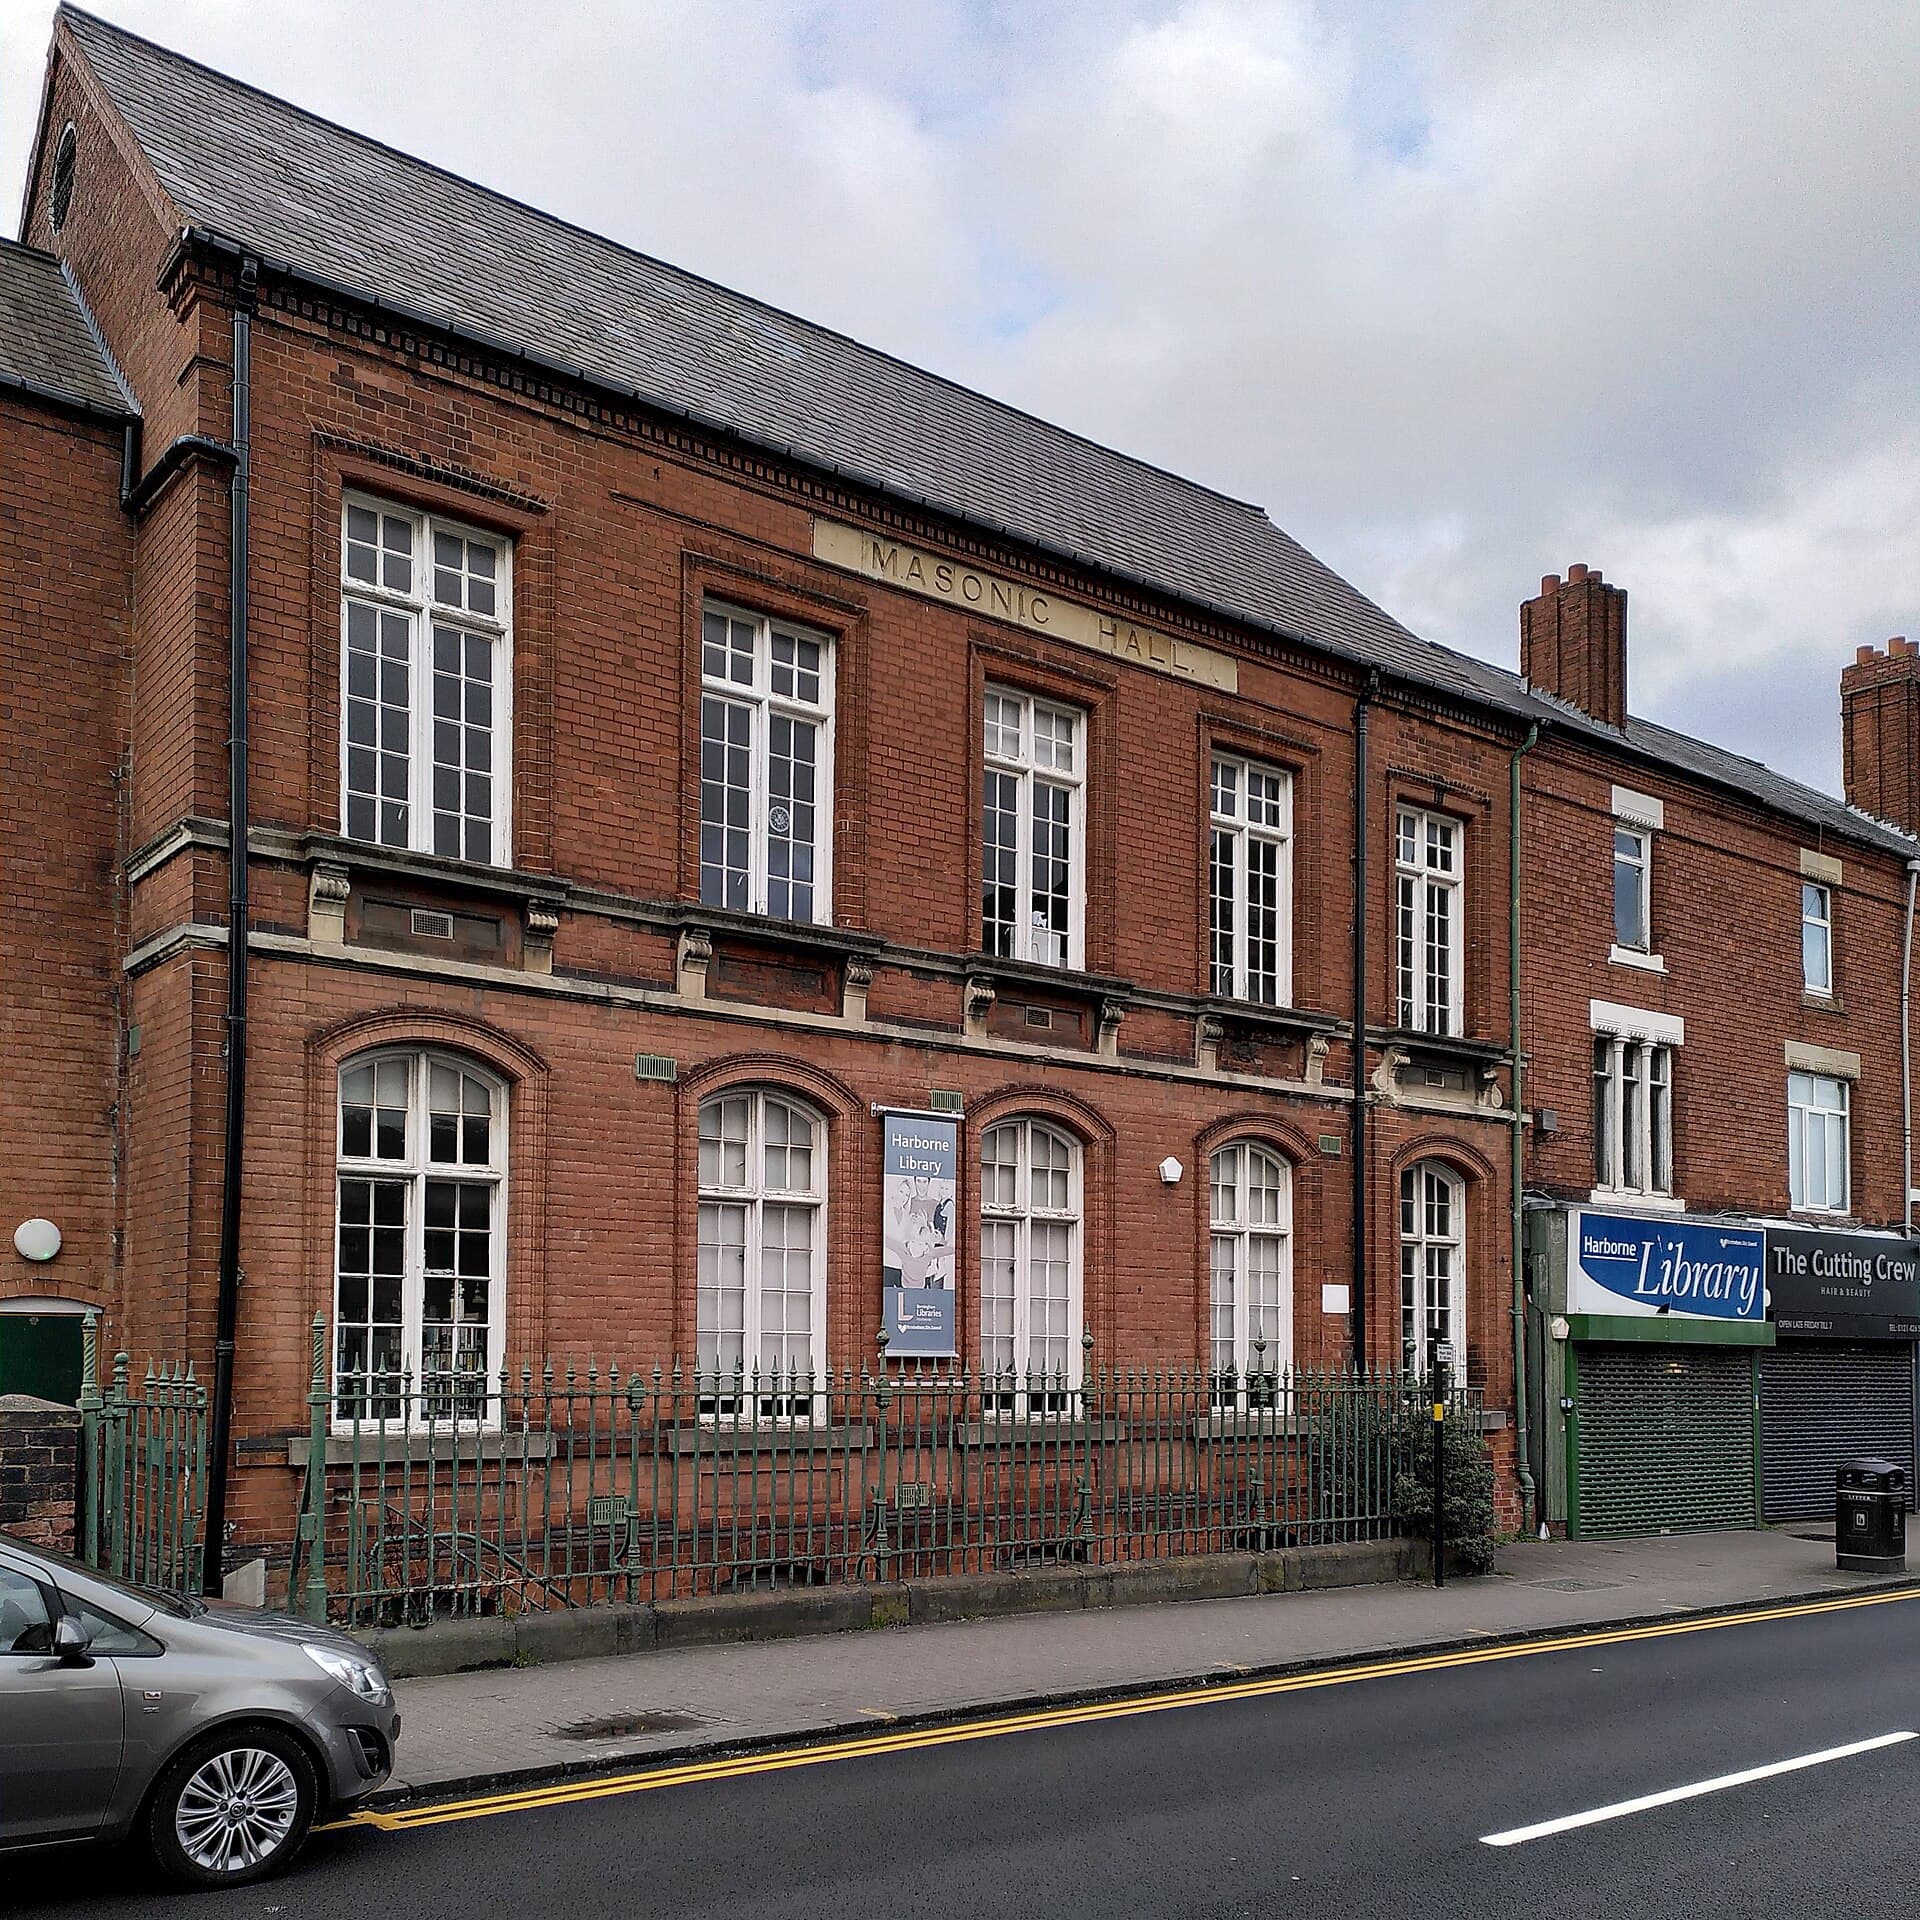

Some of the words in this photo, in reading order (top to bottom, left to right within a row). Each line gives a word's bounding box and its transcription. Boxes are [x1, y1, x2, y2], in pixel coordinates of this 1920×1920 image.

[871, 540, 1050, 625] MASONIC
[892, 1132, 949, 1151] Harborne
[899, 1155, 942, 1175] Library
[1773, 1246, 1807, 1275] The
[1812, 1249, 1872, 1285] Cutting
[1876, 1254, 1916, 1282] Crew
[1584, 1236, 1637, 1256] Harborne
[1633, 1241, 1759, 1316] Library
[1821, 1287, 1837, 1296] HAIR
[1846, 1288, 1871, 1297] BEAUTY
[917, 1308, 942, 1317] Libraries
[1779, 1320, 1792, 1328] OPEN
